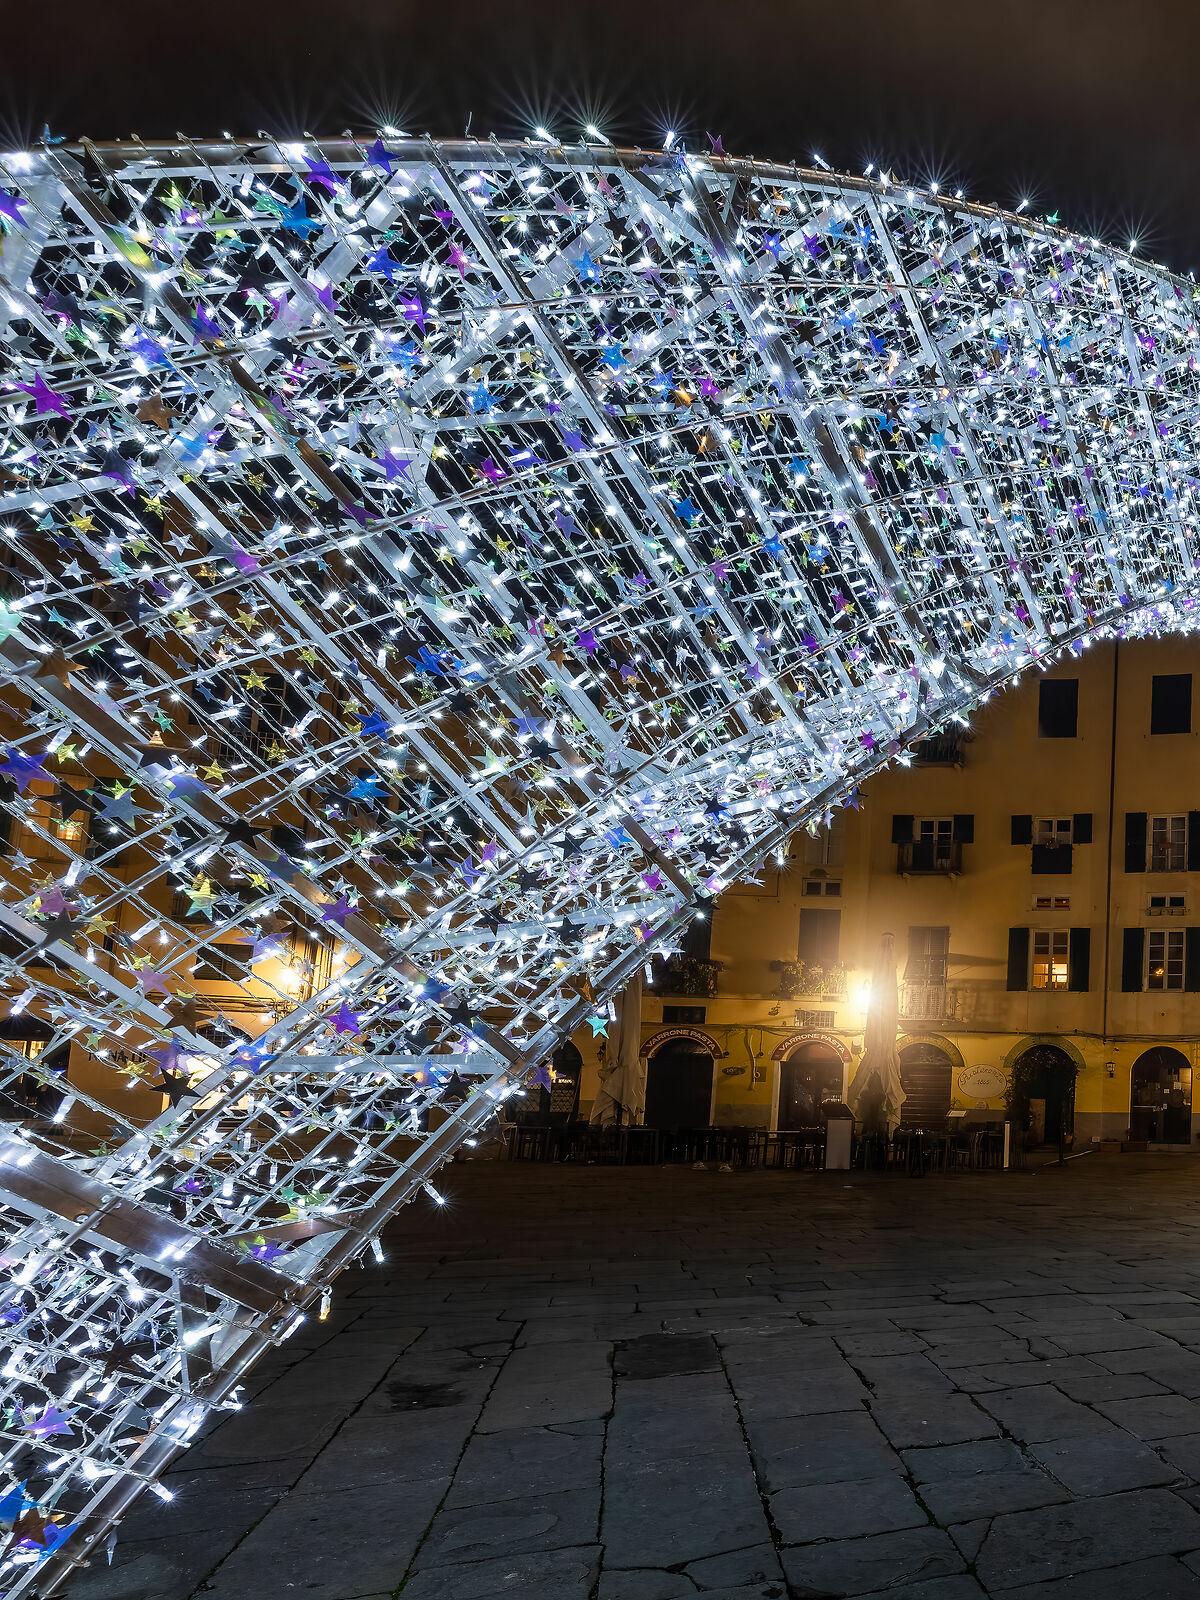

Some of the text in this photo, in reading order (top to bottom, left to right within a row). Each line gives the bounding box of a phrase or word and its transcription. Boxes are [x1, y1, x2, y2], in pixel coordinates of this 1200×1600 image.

[646, 1029, 716, 1051] VARRONE PASTA
[779, 1033, 845, 1054] VARRONE PASTA
